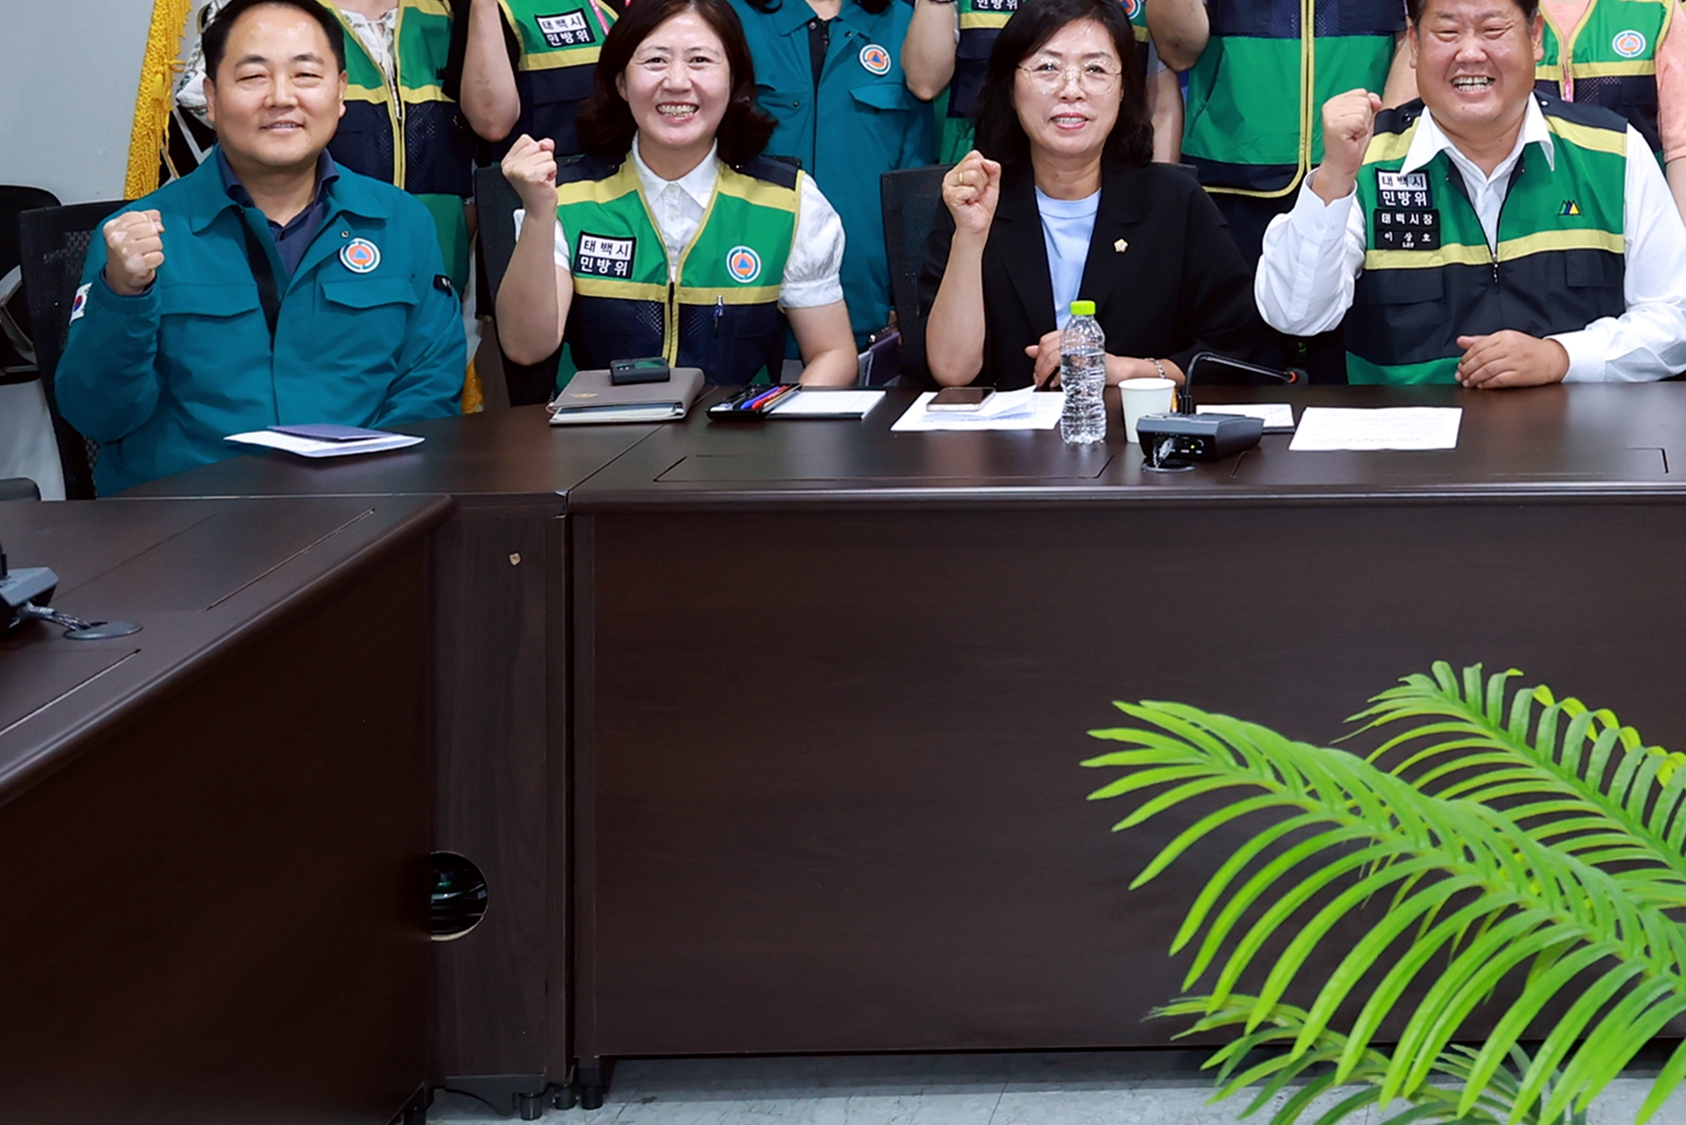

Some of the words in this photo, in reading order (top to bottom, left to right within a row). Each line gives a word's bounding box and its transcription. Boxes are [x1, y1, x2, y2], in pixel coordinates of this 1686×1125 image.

[546, 29, 591, 46] 민방위
[1381, 175, 1424, 188] 태백시
[1382, 190, 1427, 206] 민방위
[583, 240, 629, 257] 태백시
[580, 256, 628, 276] 민방위
